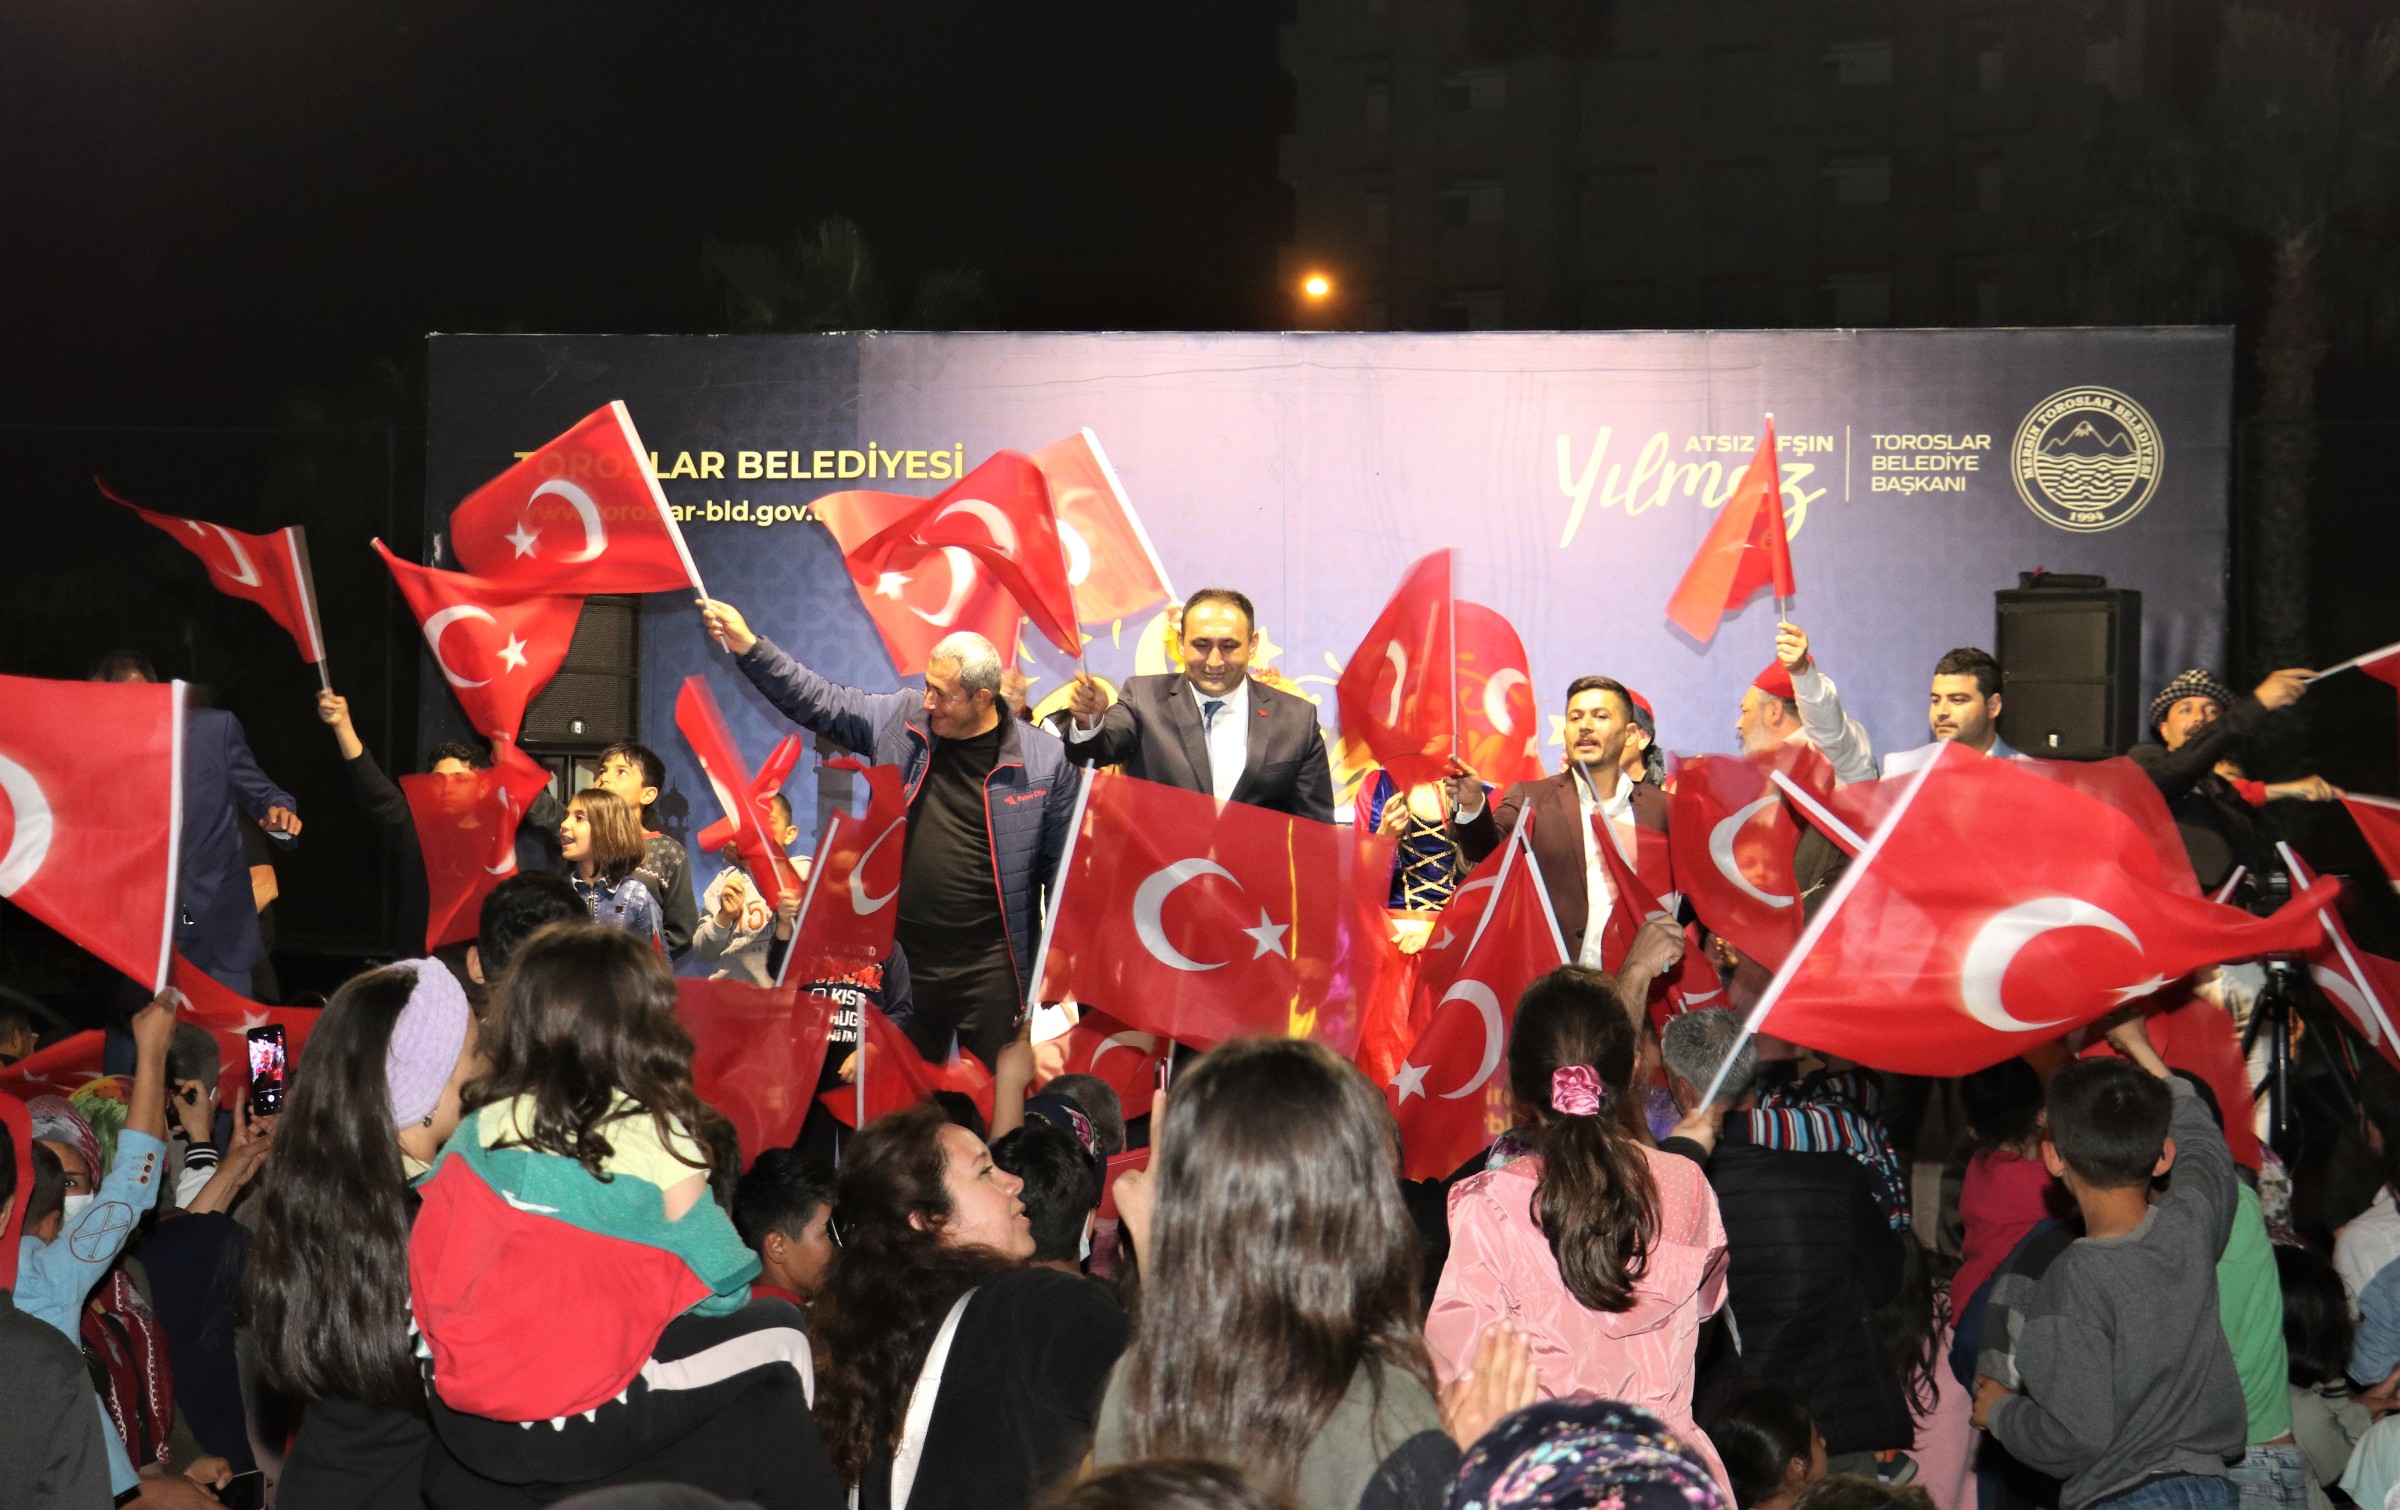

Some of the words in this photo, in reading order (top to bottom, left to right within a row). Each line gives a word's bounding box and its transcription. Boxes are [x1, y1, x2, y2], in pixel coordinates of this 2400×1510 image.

[1685, 435, 1755, 452] ATSIZ
[1773, 435, 1833, 456] FŞIN
[1870, 434, 1991, 451] TOROSLAR
[514, 450, 725, 480] OROLAR
[737, 441, 964, 479] BELEDİYESİ
[1870, 453, 1980, 472] BELEDİYE
[1870, 476, 1967, 497] BAŞKANI
